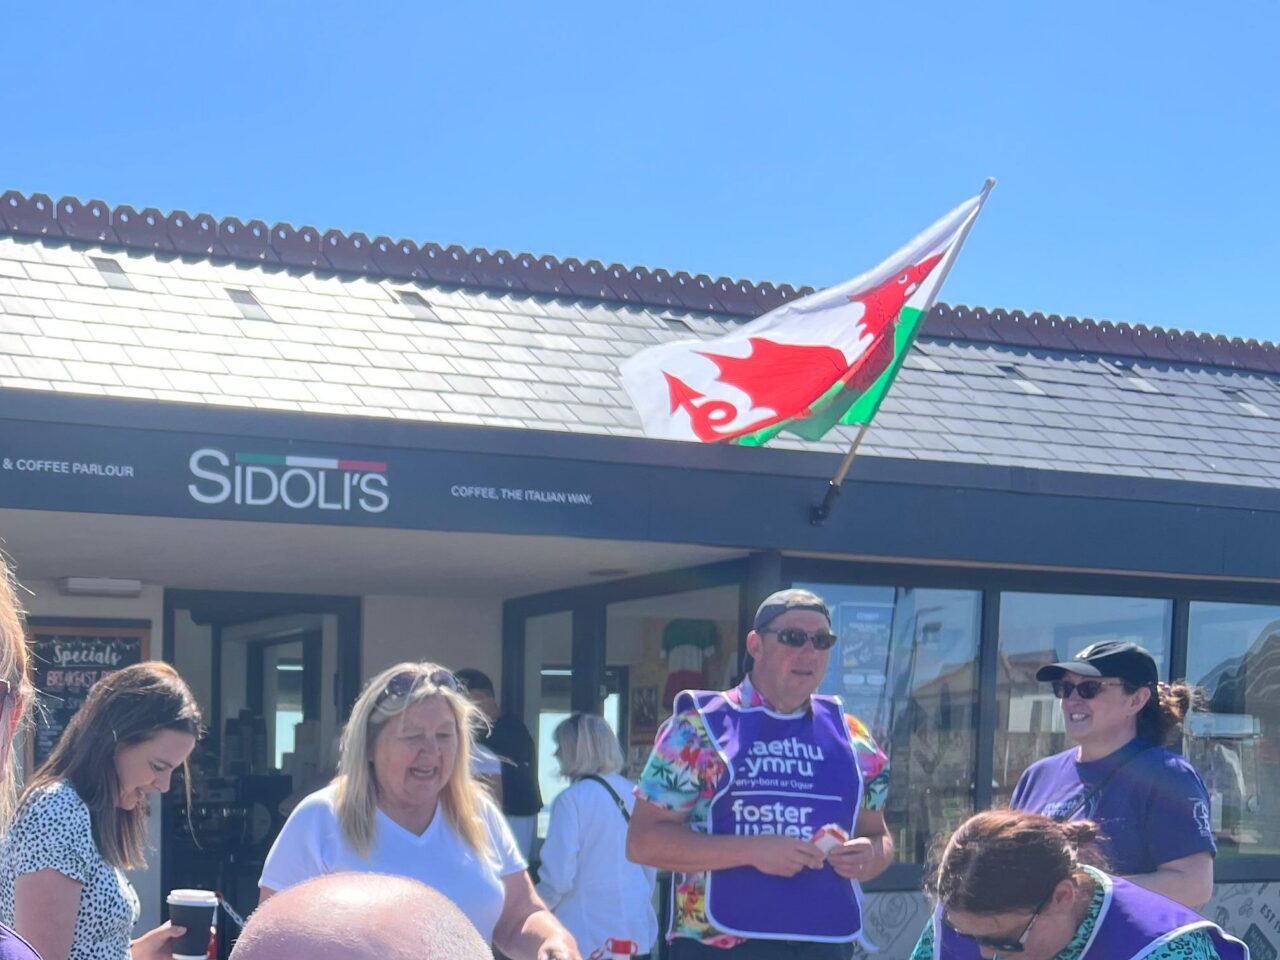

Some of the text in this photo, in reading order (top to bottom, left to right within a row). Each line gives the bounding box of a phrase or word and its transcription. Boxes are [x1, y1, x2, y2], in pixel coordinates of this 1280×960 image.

[2, 458, 13, 470] &
[16, 458, 70, 474] COFFEE
[72, 462, 135, 477] PARLOUR
[187, 448, 390, 513] SIDOLI'S
[450, 485, 499, 500] COFFEE,
[500, 488, 524, 500] THE
[524, 489, 565, 503] ITALIAN
[52, 643, 122, 667] Specials
[747, 737, 824, 761] aethu
[731, 799, 813, 824] foster
[1260, 904, 1276, 923] EST
